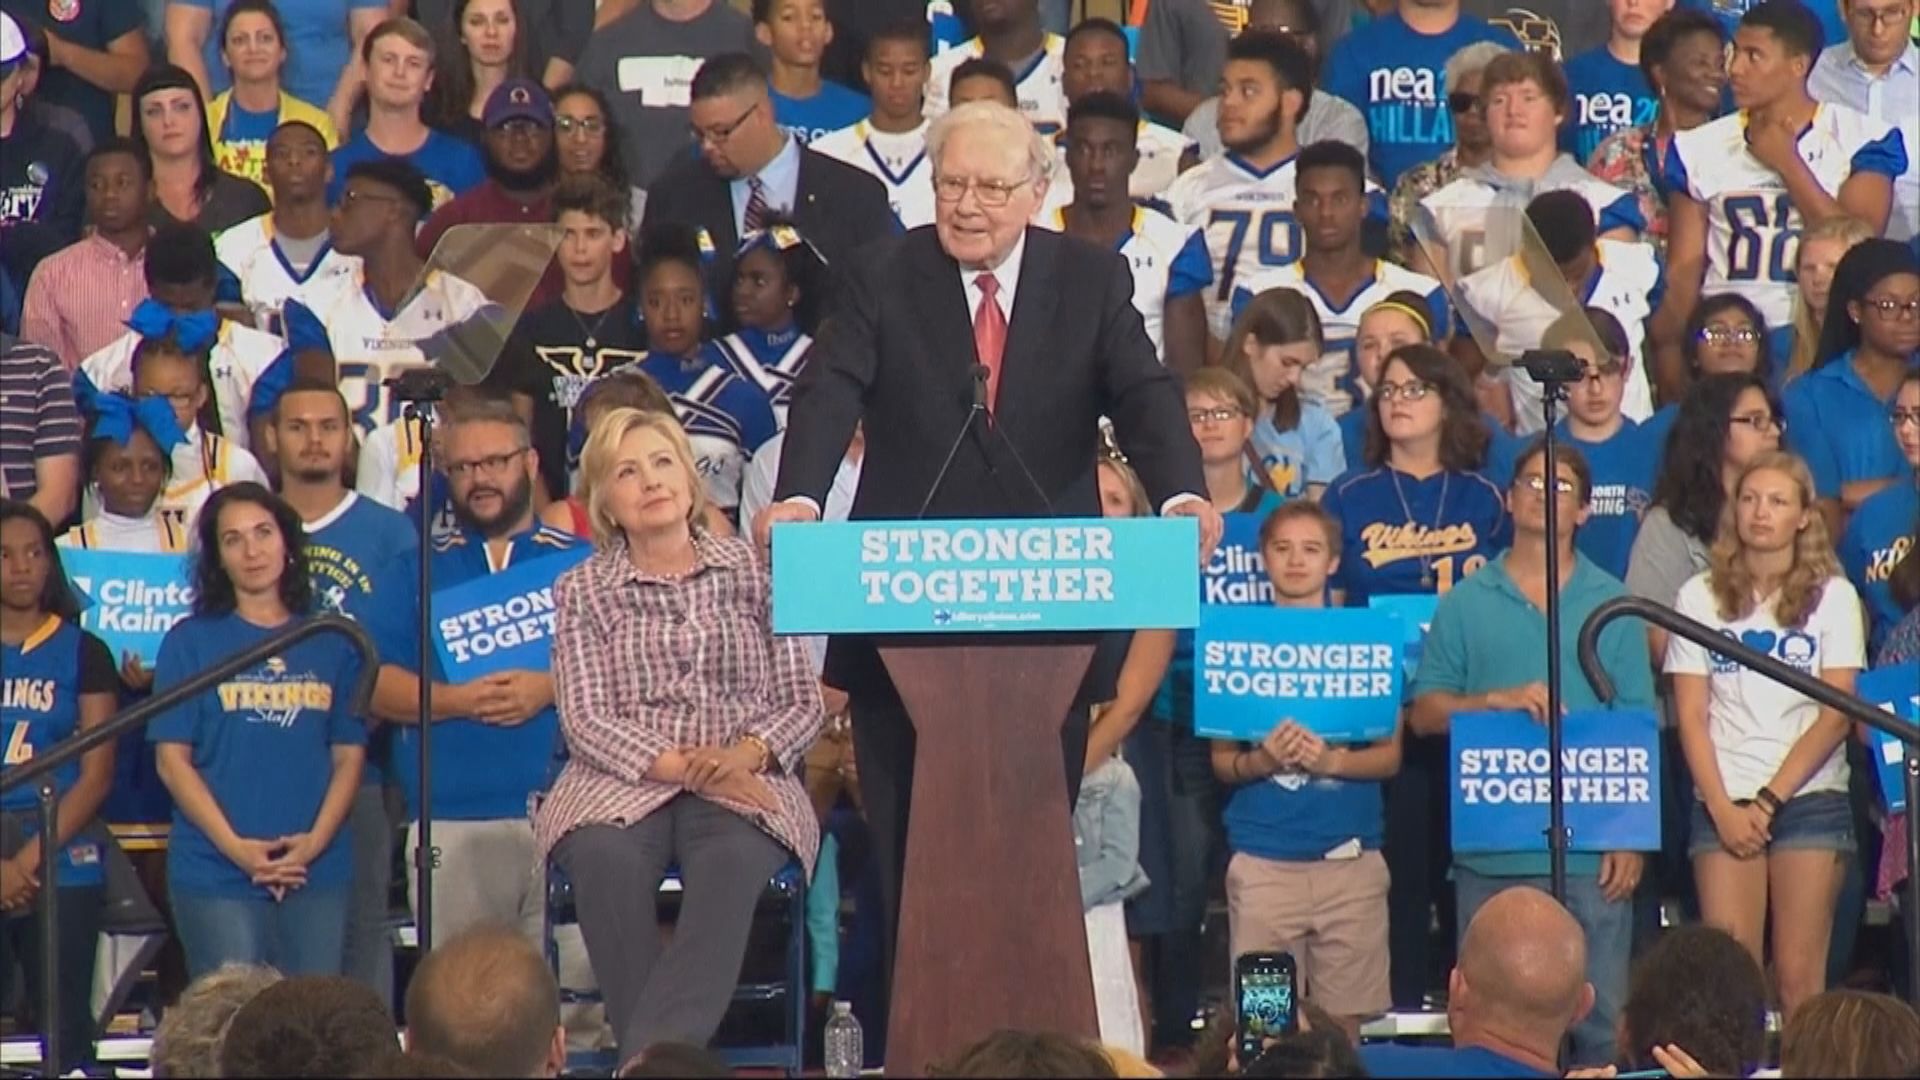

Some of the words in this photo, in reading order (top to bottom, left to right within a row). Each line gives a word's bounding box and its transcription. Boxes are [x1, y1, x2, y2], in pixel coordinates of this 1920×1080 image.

[1370, 67, 1435, 102] nea
[1575, 92, 1632, 126] nea
[1208, 209, 1303, 300] 70
[362, 337, 417, 350] VIKING
[861, 526, 1114, 564] STRONGER
[861, 567, 1114, 604] TOGETHER
[440, 587, 556, 641] STRON
[446, 612, 556, 664] TOGET
[1204, 641, 1393, 670] STRONGER
[217, 682, 333, 712] VIKINGS
[1203, 670, 1392, 698] TOGETHER
[1460, 748, 1650, 775] STRONGER
[1460, 777, 1651, 804] TOGETHER
